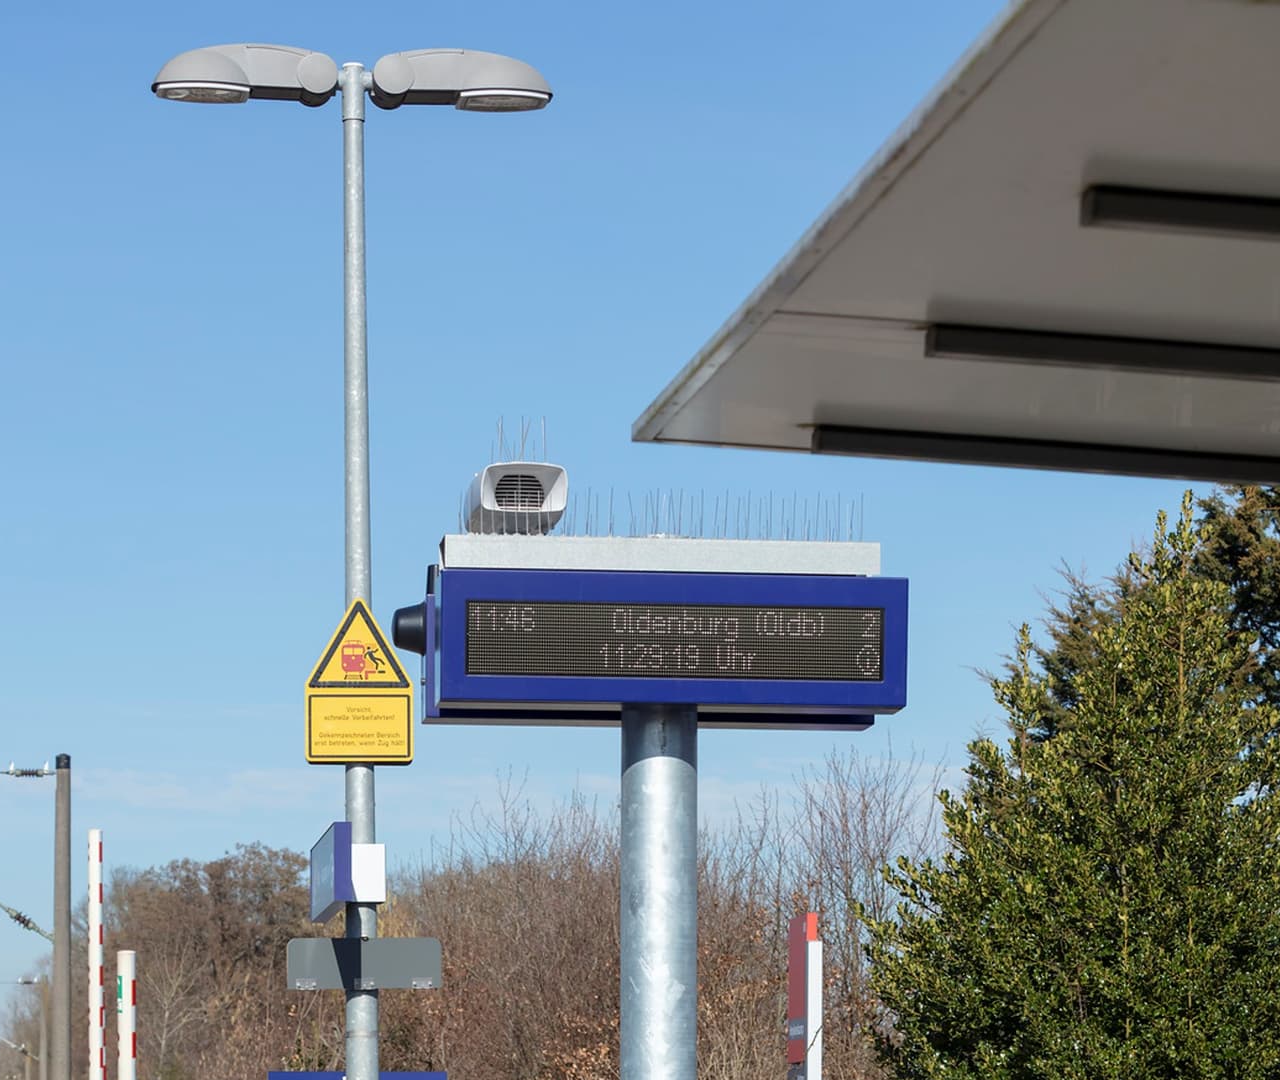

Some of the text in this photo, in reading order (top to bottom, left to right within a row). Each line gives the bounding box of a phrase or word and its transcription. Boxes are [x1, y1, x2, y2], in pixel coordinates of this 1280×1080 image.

[471, 606, 876, 642] 11:46 Oldenburg (Oldb) 2
[599, 643, 757, 670] 11:29:19 Uhr
